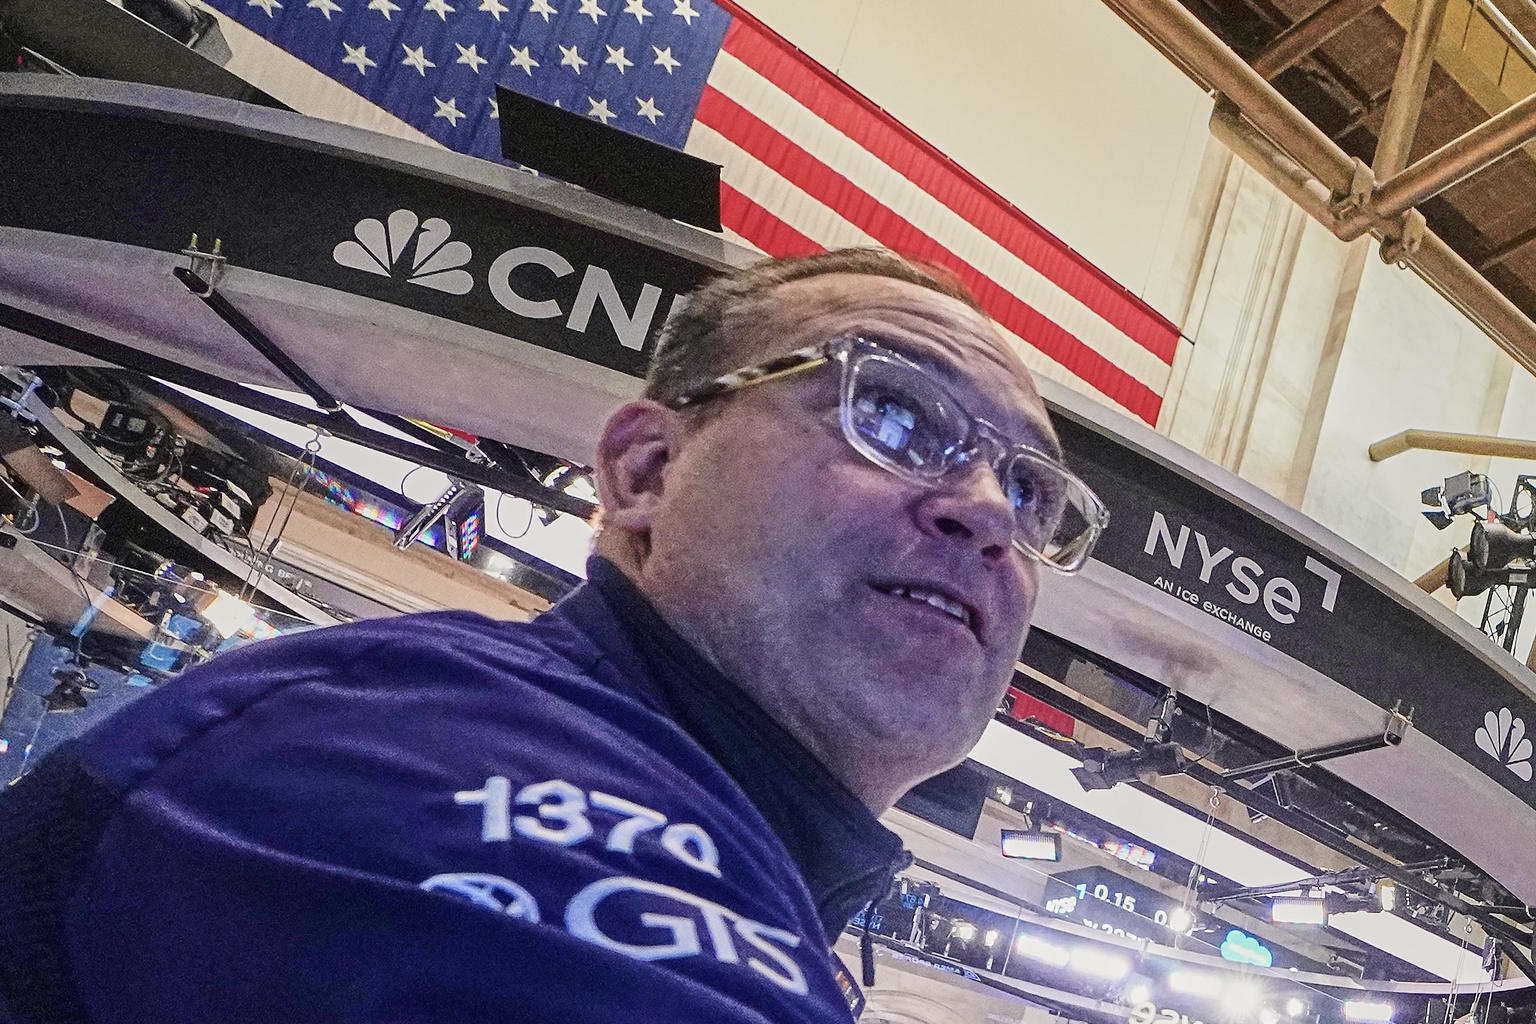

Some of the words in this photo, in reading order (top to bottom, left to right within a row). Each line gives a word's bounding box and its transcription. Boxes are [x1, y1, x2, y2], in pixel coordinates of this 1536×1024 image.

[488, 246, 690, 352] CN
[1153, 576, 1175, 594] AN
[1094, 884, 1137, 913] 0.15
[565, 875, 809, 996] GTS
